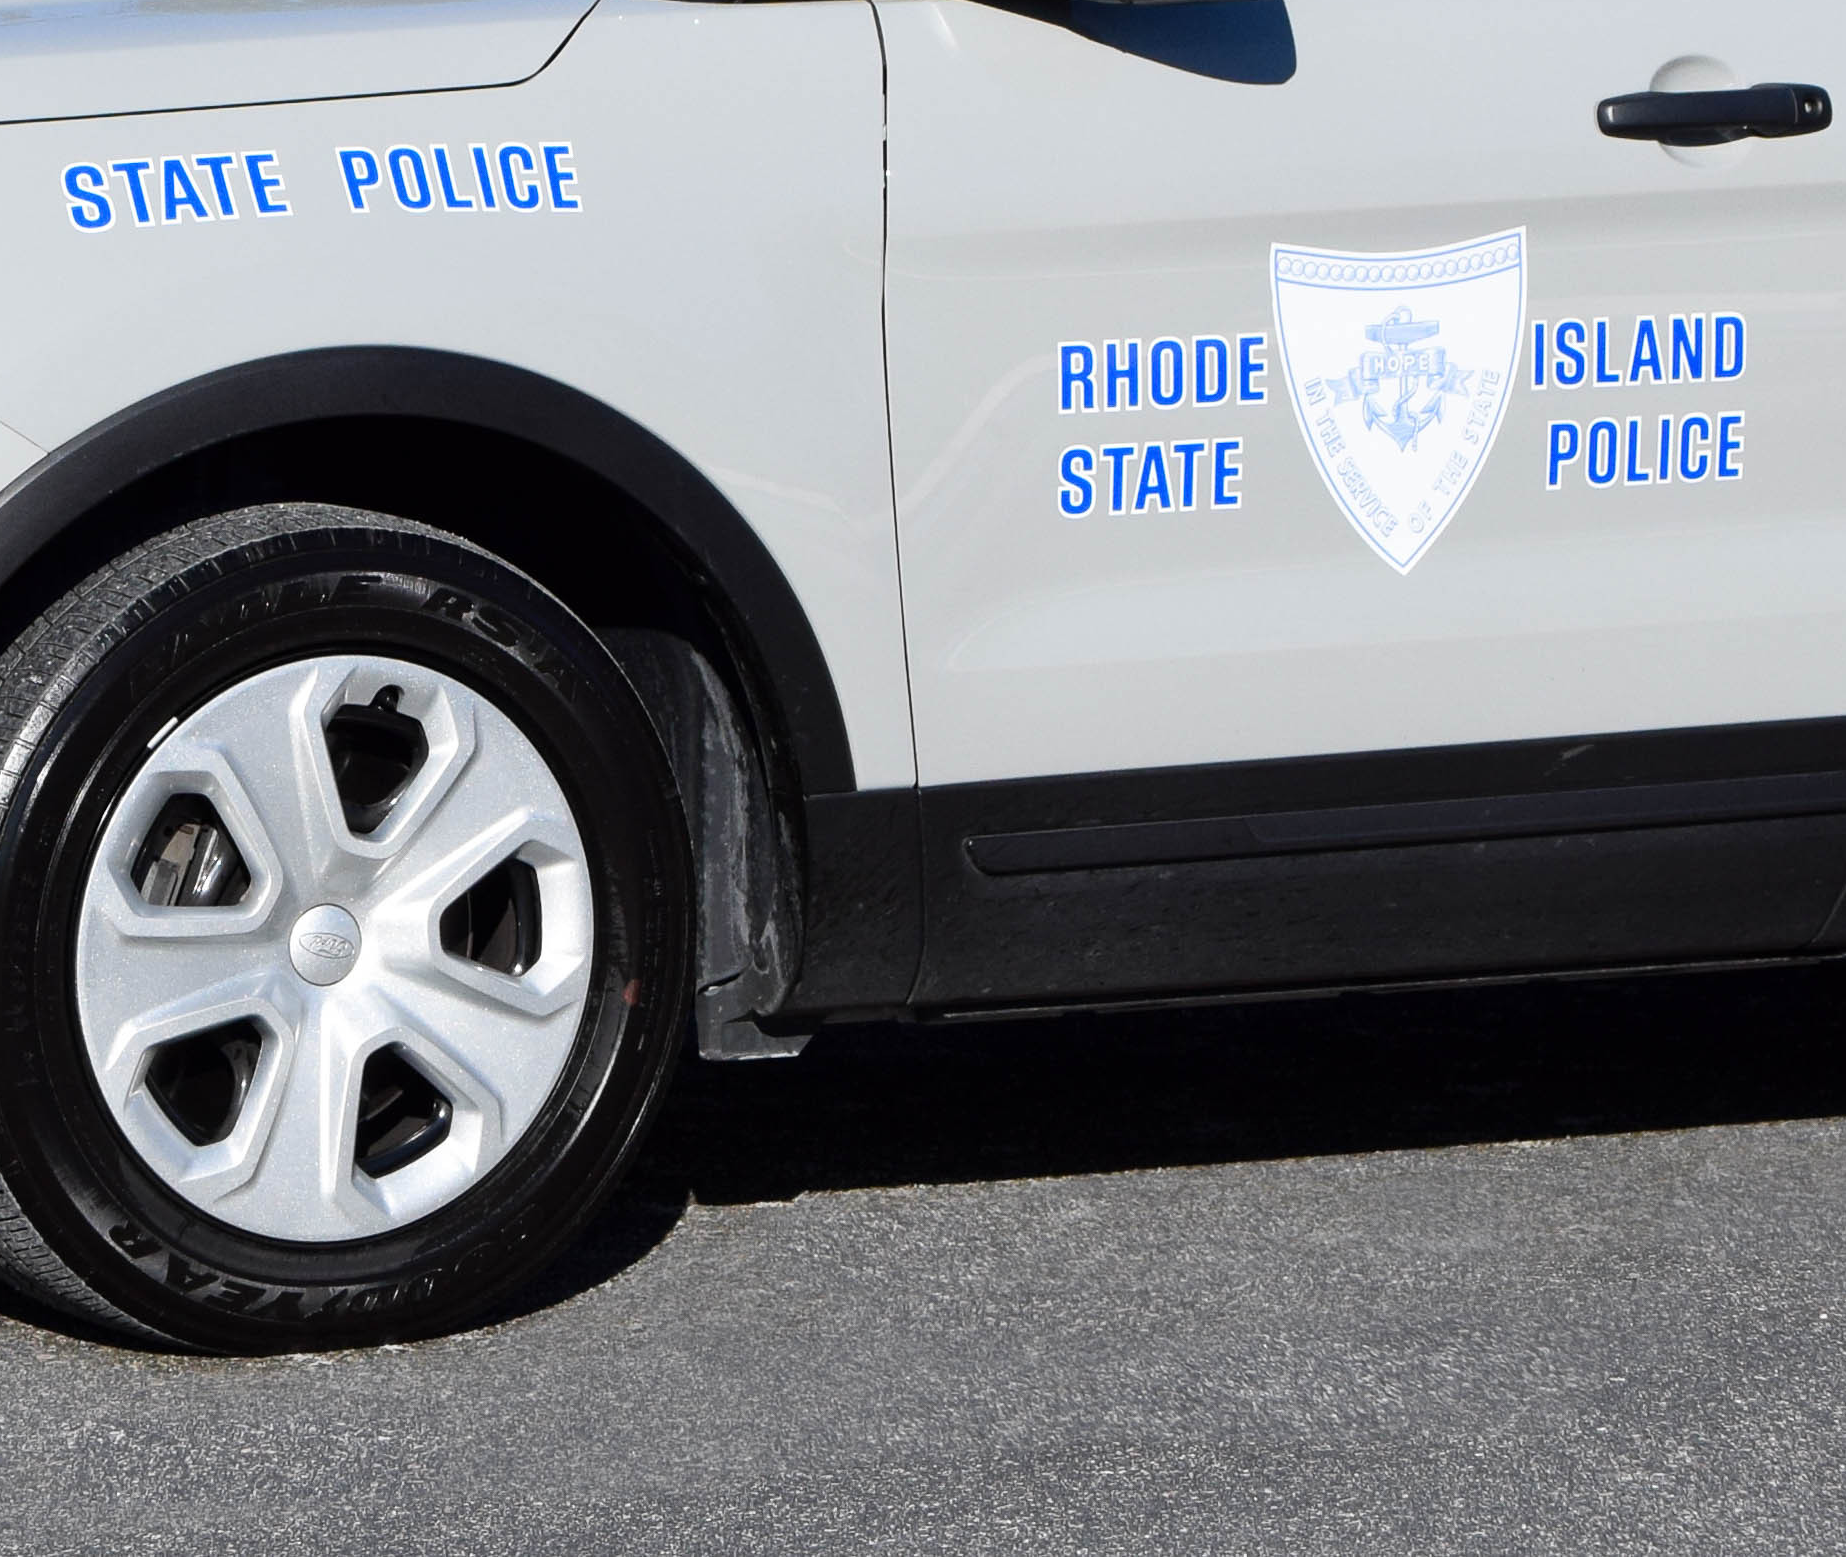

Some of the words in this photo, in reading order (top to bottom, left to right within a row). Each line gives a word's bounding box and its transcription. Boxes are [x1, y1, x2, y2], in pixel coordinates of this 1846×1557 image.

[62, 152, 291, 231] STATE
[337, 142, 582, 212] POLICE
[1059, 335, 1267, 413] RHODE
[1531, 313, 1747, 390] ISLAND
[1373, 354, 1430, 374] HOPE
[1058, 440, 1242, 518] STATE
[1546, 412, 1745, 490] POLICE
[1304, 377, 1326, 406] IN
[1316, 409, 1346, 458] THE
[1337, 456, 1399, 538] SERVICE
[1409, 500, 1433, 534] OF
[1433, 450, 1469, 495] THE
[1464, 368, 1500, 445] STATE
